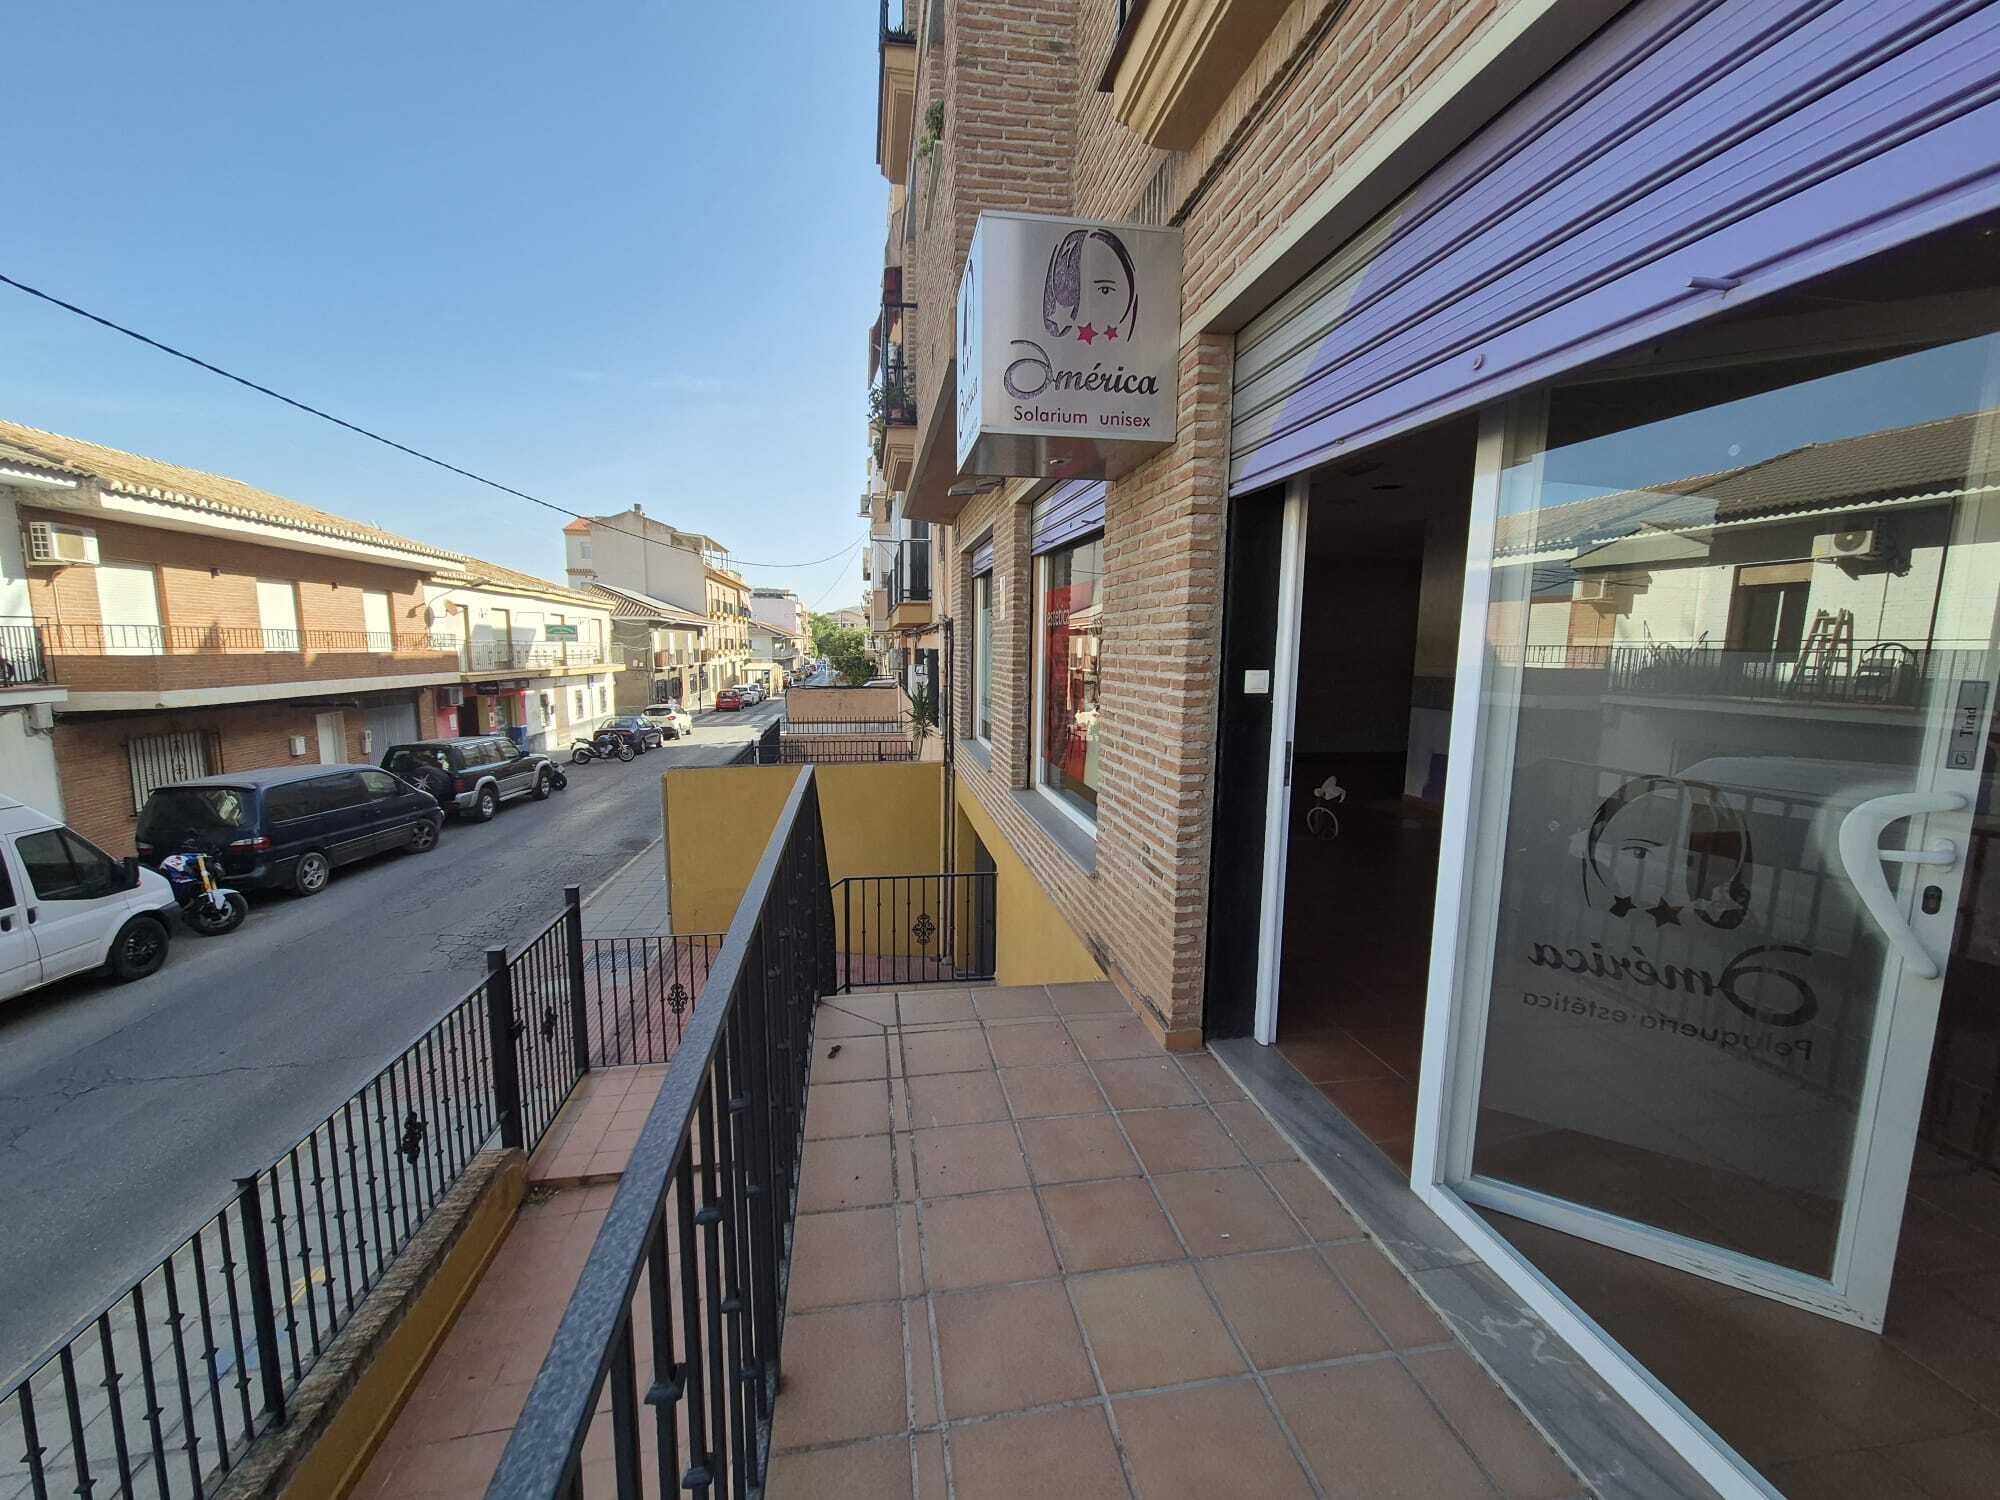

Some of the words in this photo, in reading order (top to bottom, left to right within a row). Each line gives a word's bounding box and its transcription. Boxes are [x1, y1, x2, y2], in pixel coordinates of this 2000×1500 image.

[1003, 339, 1159, 402] América
[1014, 405, 1088, 425] Solarium
[1099, 410, 1151, 427] unisex
[1958, 706, 1977, 738] Tirad
